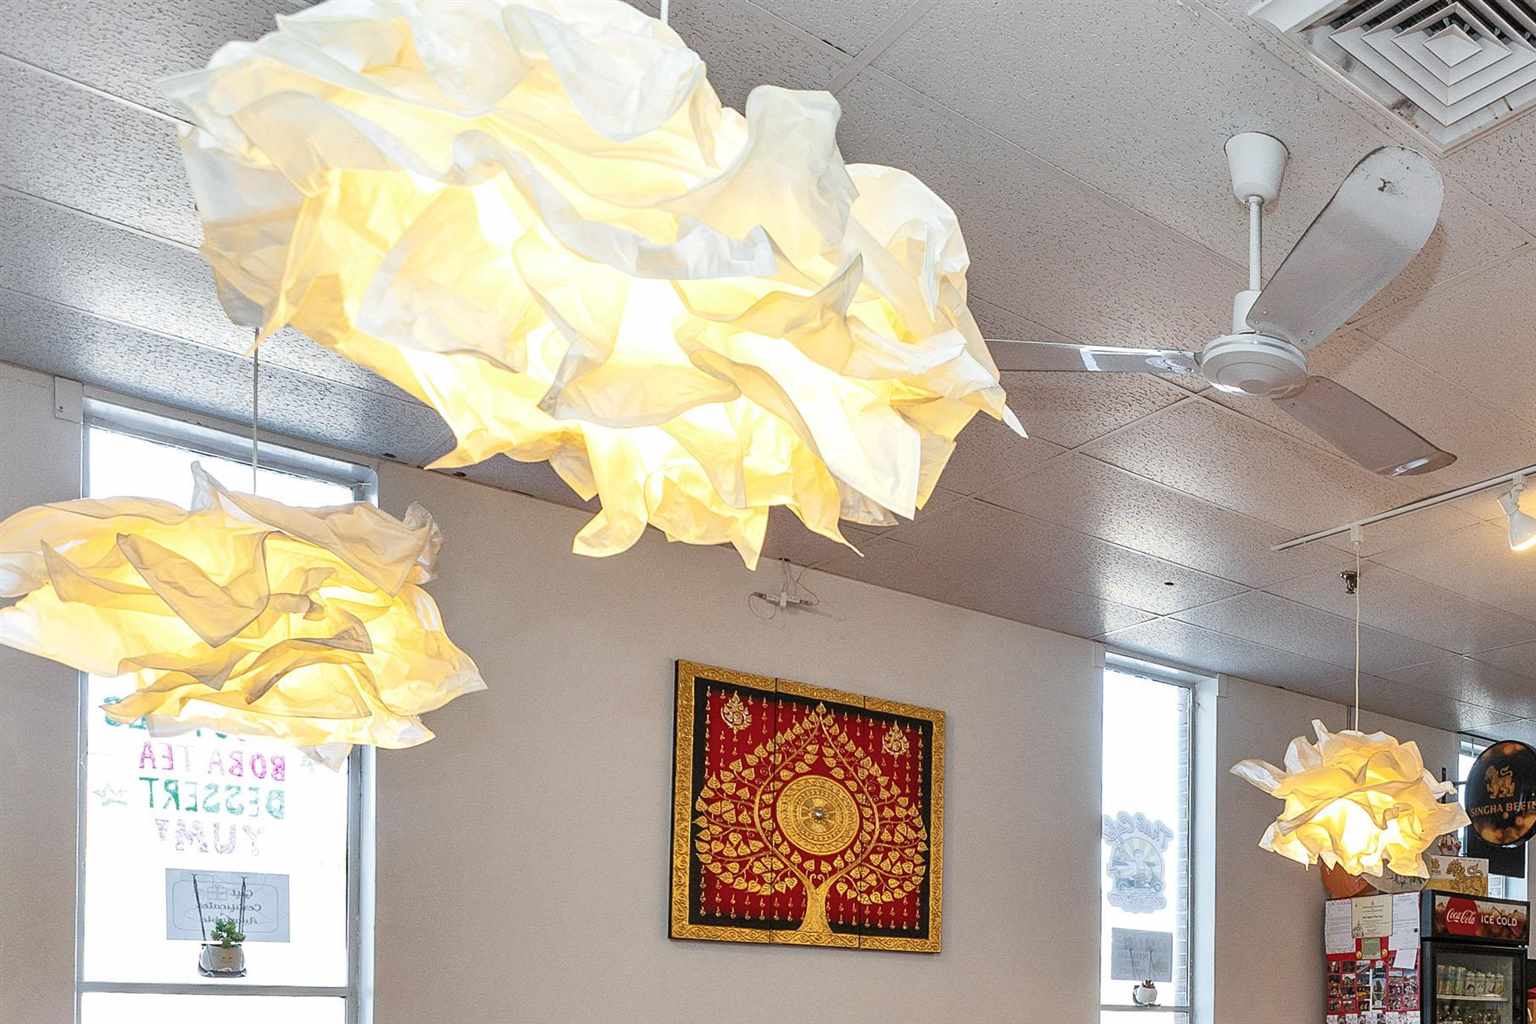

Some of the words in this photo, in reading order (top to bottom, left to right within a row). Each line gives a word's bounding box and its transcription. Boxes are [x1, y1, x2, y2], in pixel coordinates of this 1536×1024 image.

[1470, 803, 1504, 818] SINGHA
[1480, 915, 1495, 925] ICE
[1496, 916, 1518, 927] COLD
